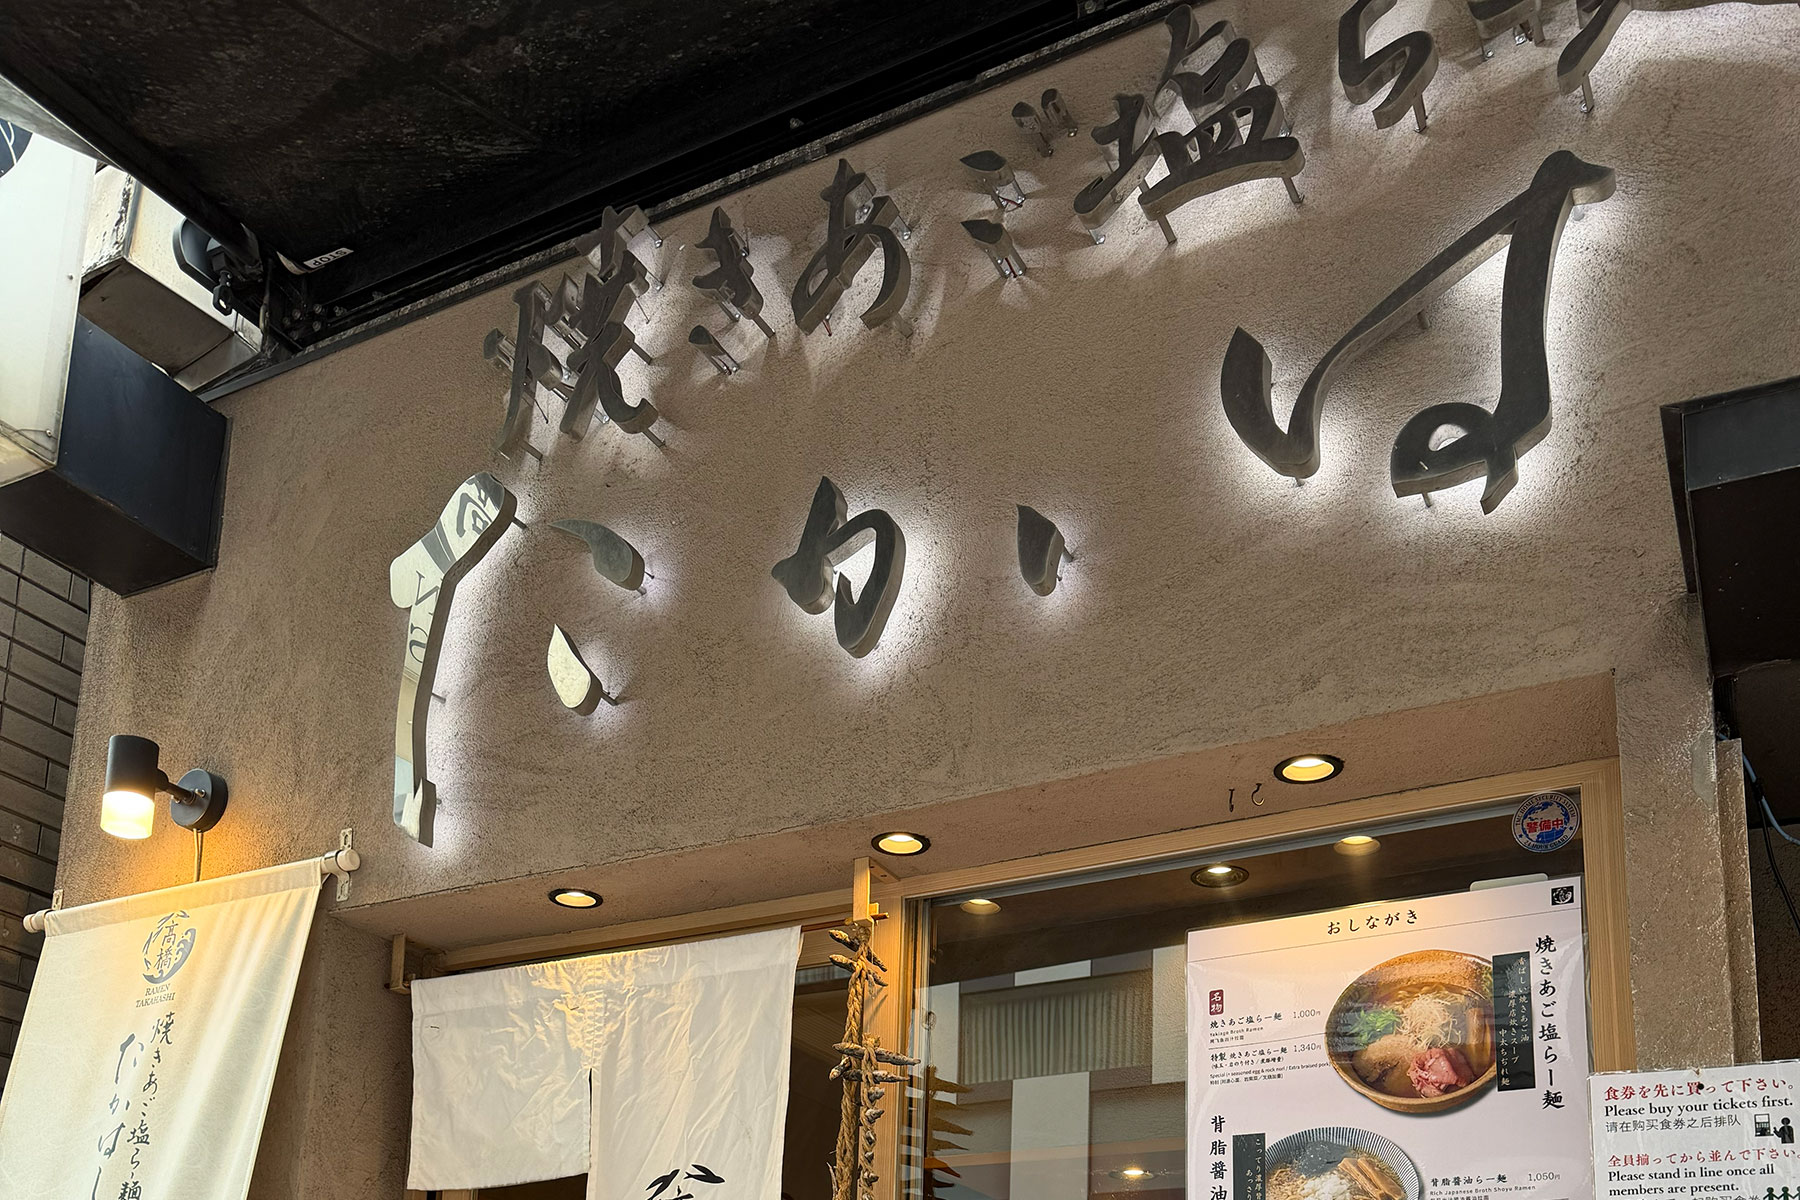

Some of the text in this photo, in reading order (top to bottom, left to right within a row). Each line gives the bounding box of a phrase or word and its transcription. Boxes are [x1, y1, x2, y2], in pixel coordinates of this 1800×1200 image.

[484, 0, 1632, 462] 焼きあご塩ら
[1527, 818, 1564, 833] 警備中
[1327, 908, 1419, 936] おしながき
[145, 983, 171, 997] RAMEN
[135, 992, 176, 1008] TAKAHASHI
[1211, 991, 1222, 1013] 名物
[1209, 1012, 1283, 1029] 焼きあご塩らー麺
[1535, 935, 1565, 1110] 焼きあご塩らー麺
[1210, 1052, 1228, 1062] 特製
[1229, 1046, 1288, 1060] 焼きあご塩らー麺
[1604, 1078, 1794, 1101] 食券を先に買って下さい。
[1604, 1095, 1793, 1117] Please buy your tickets first.
[1605, 1114, 1741, 1133] 请在购买食券之后排队
[1431, 1172, 1561, 1188] 背脂醤油らー麺 1,050円
[1608, 1164, 1775, 1182] Please stand in line once all
[1444, 1188, 1474, 1196] Japanese
[1493, 1186, 1513, 1194] Shoyu
[1609, 1183, 1739, 1196] members are present.
